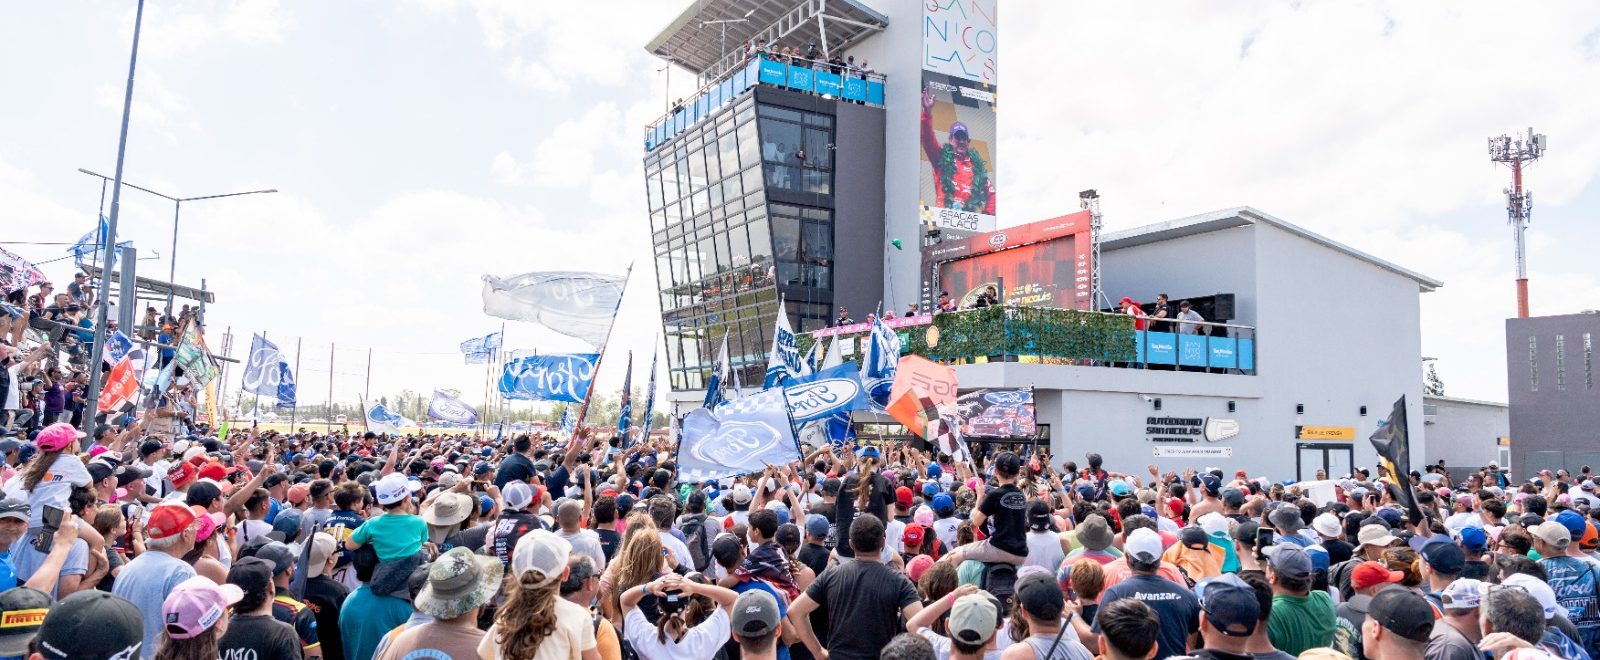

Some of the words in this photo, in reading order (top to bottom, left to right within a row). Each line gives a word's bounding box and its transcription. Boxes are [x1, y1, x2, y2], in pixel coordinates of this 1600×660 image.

[940, 210, 979, 222] GRACIAS
[942, 217, 977, 230] FLACO
[1134, 591, 1177, 600] Avanzar
[5, 612, 47, 625] PIRELL
